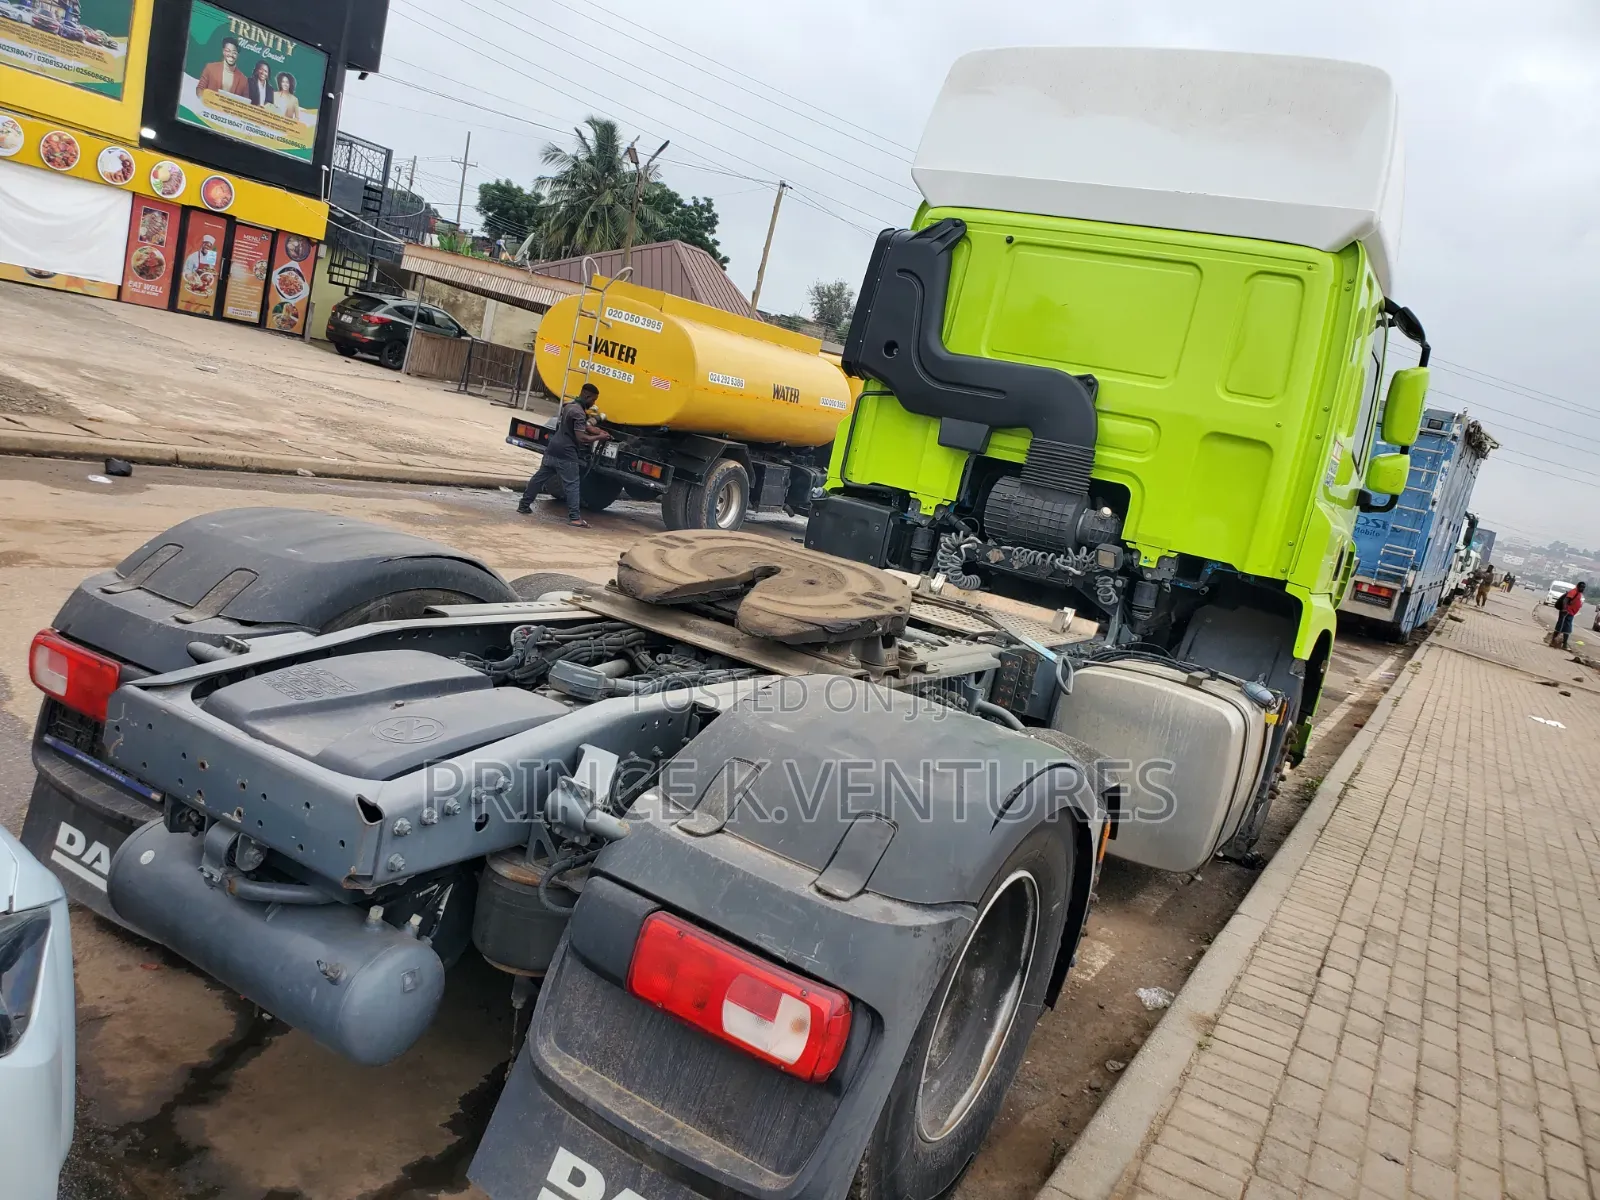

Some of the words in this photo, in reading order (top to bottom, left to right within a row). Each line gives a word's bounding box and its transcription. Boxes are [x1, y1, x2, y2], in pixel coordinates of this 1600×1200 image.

[227, 15, 297, 56] TRINITY
[128, 280, 143, 289] EAT
[143, 283, 164, 293] WELL
[607, 308, 623, 319] 020
[624, 312, 641, 324] 050
[640, 317, 662, 331] 3995
[587, 334, 638, 366] WATER
[580, 360, 596, 371] 024
[596, 364, 612, 375] 292
[611, 368, 633, 382] 5386
[709, 372, 720, 382] 024
[720, 374, 731, 385] 292
[772, 383, 800, 404] WATER
[55, 821, 111, 876] DA
